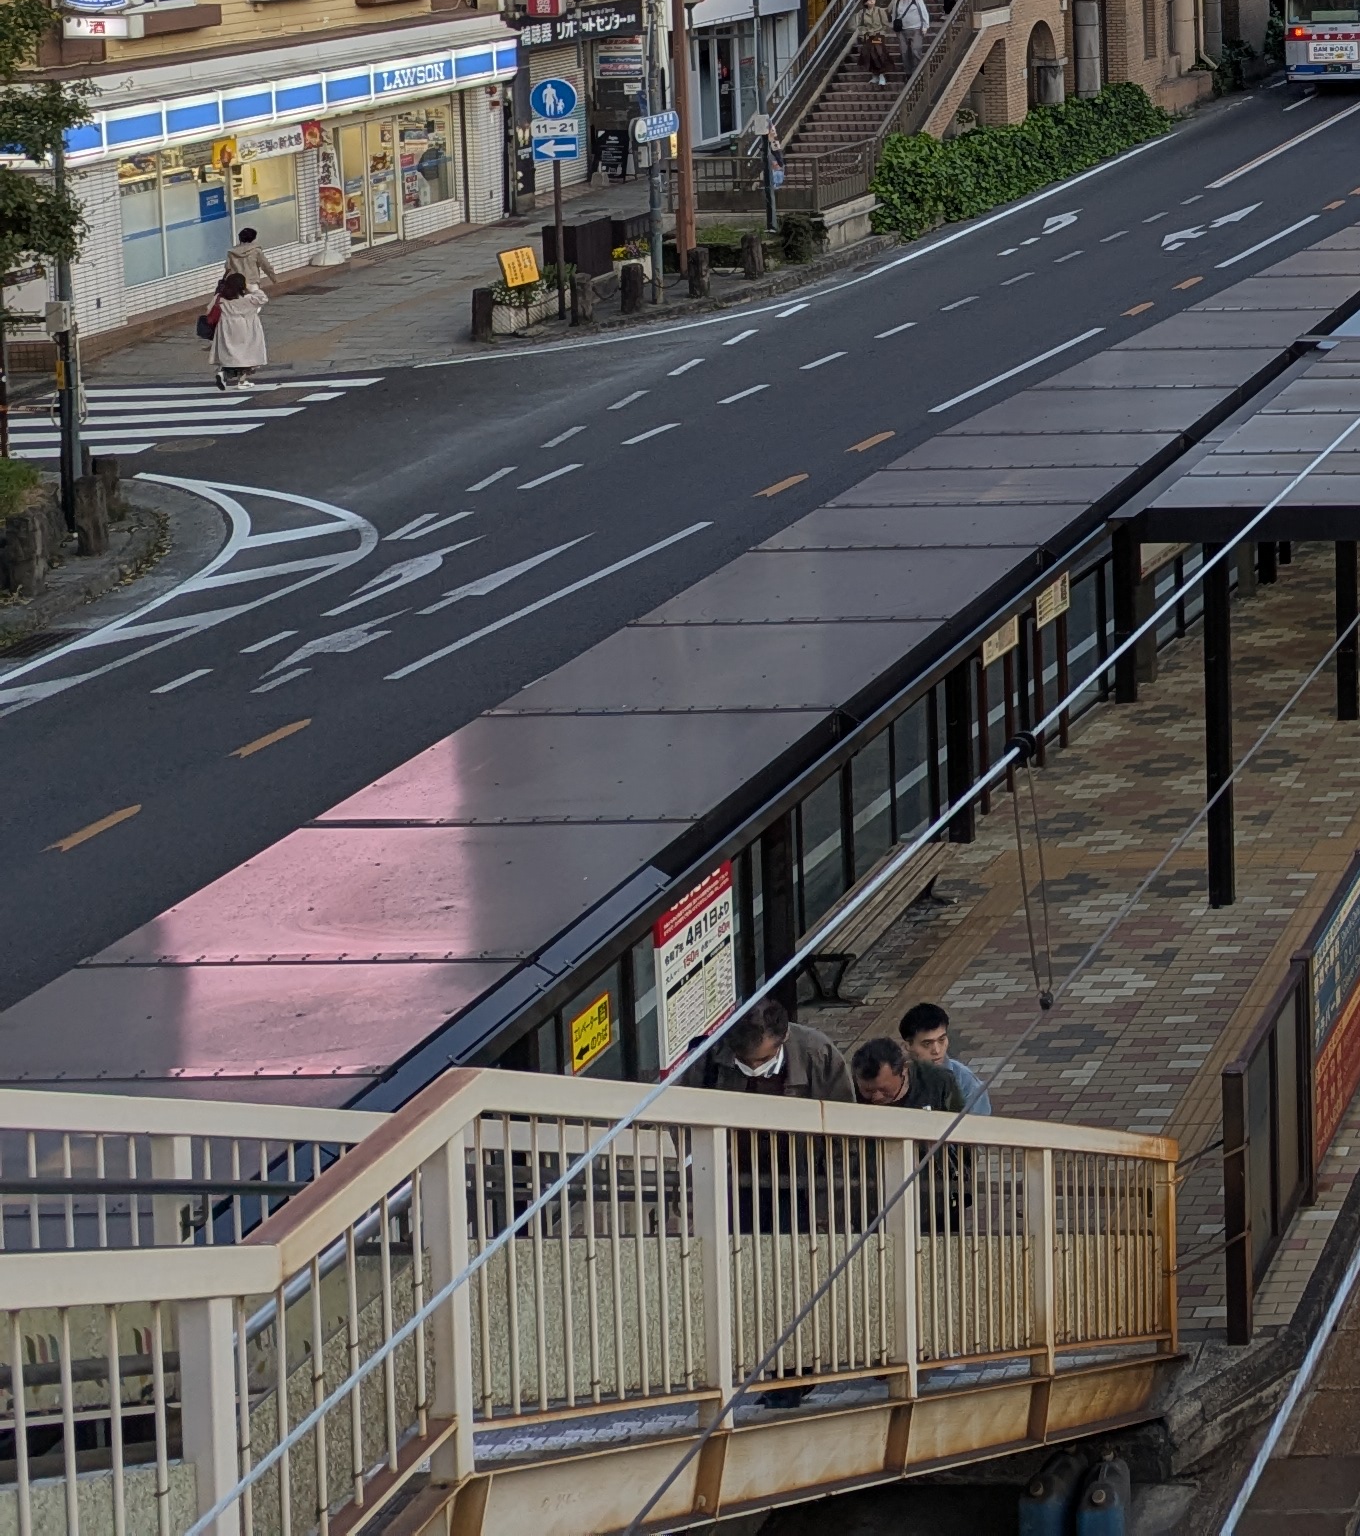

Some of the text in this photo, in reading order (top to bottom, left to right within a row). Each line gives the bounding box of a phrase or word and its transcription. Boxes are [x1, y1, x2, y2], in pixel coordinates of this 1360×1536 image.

[89, 20, 105, 35] 酒
[520, 22, 552, 47] 補聴器
[382, 62, 446, 92] LAWSON
[535, 123, 575, 134] 11-21
[685, 901, 730, 946] 4月1日より
